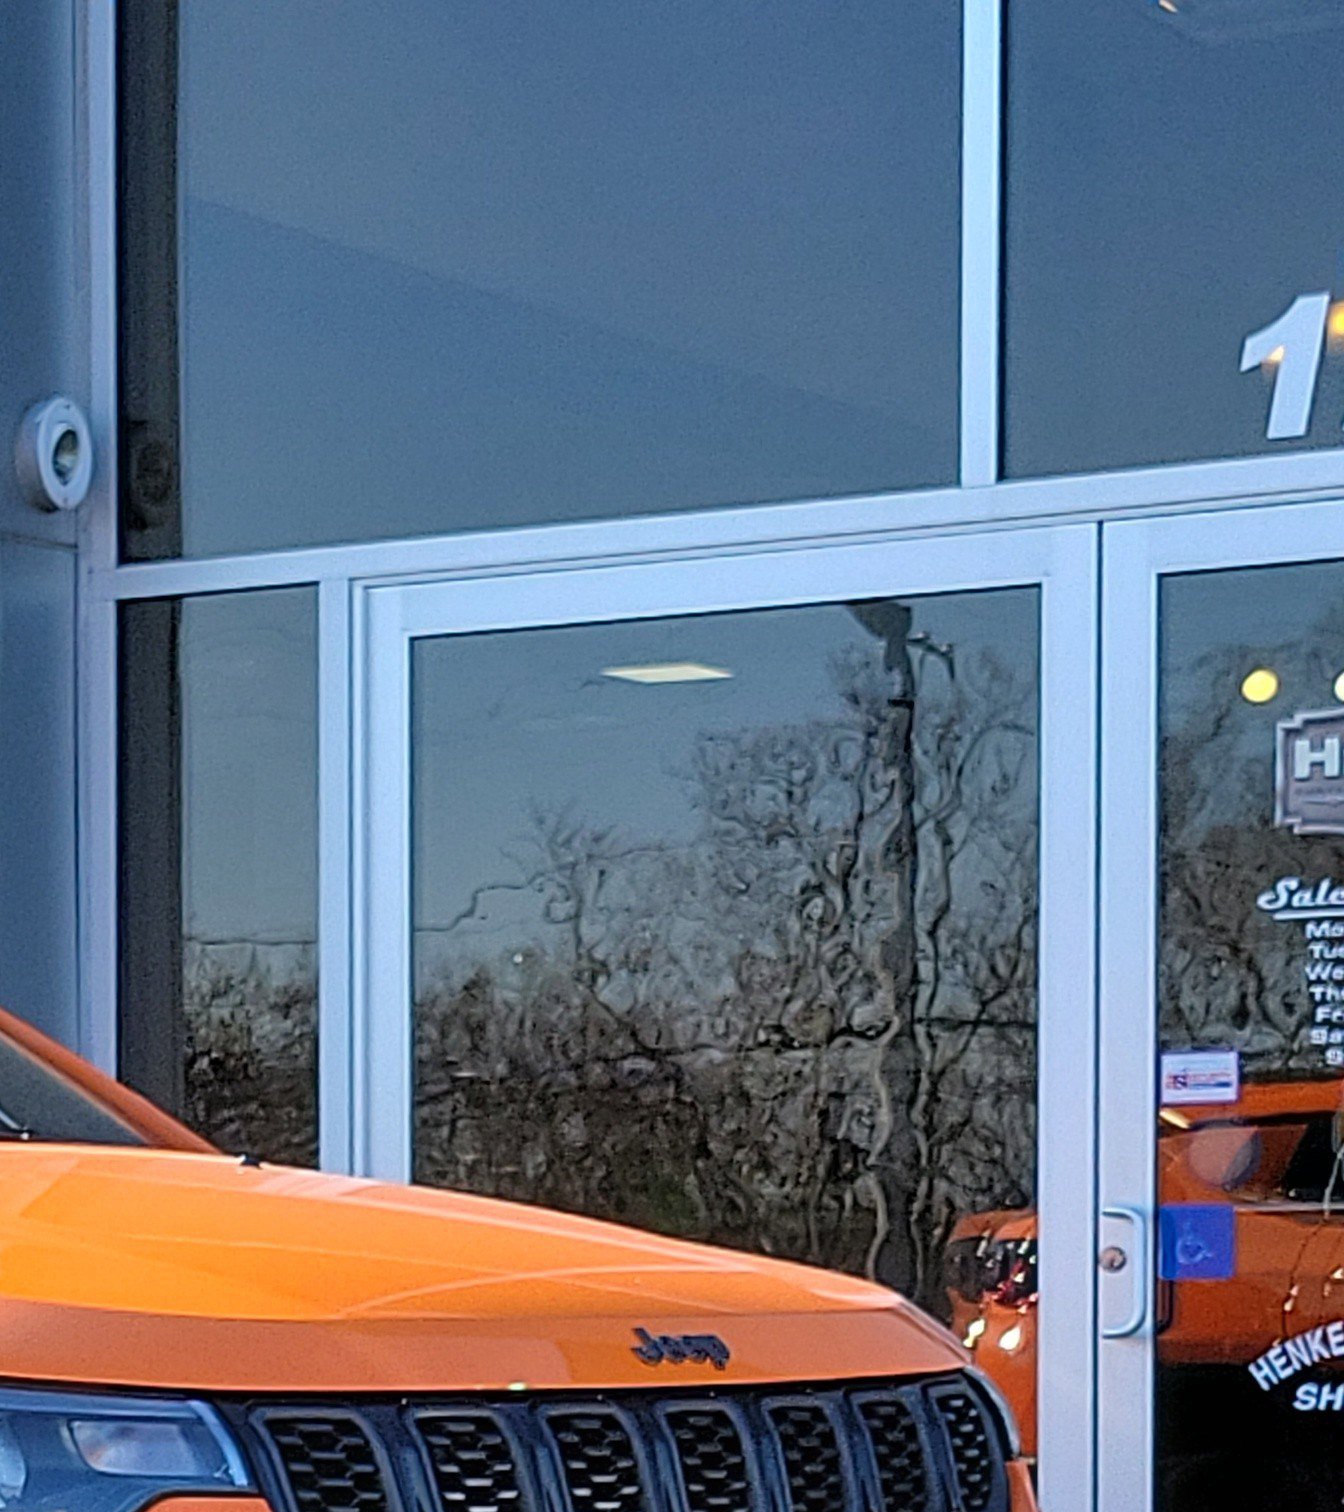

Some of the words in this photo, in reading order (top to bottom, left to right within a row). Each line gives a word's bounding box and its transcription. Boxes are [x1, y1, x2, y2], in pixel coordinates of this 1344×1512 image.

[1239, 291, 1344, 440] 1
[1294, 737, 1344, 779] H
[630, 1326, 731, 1371] Jeep
[1248, 1319, 1344, 1391] HENKE
[1292, 1381, 1344, 1411] SH
